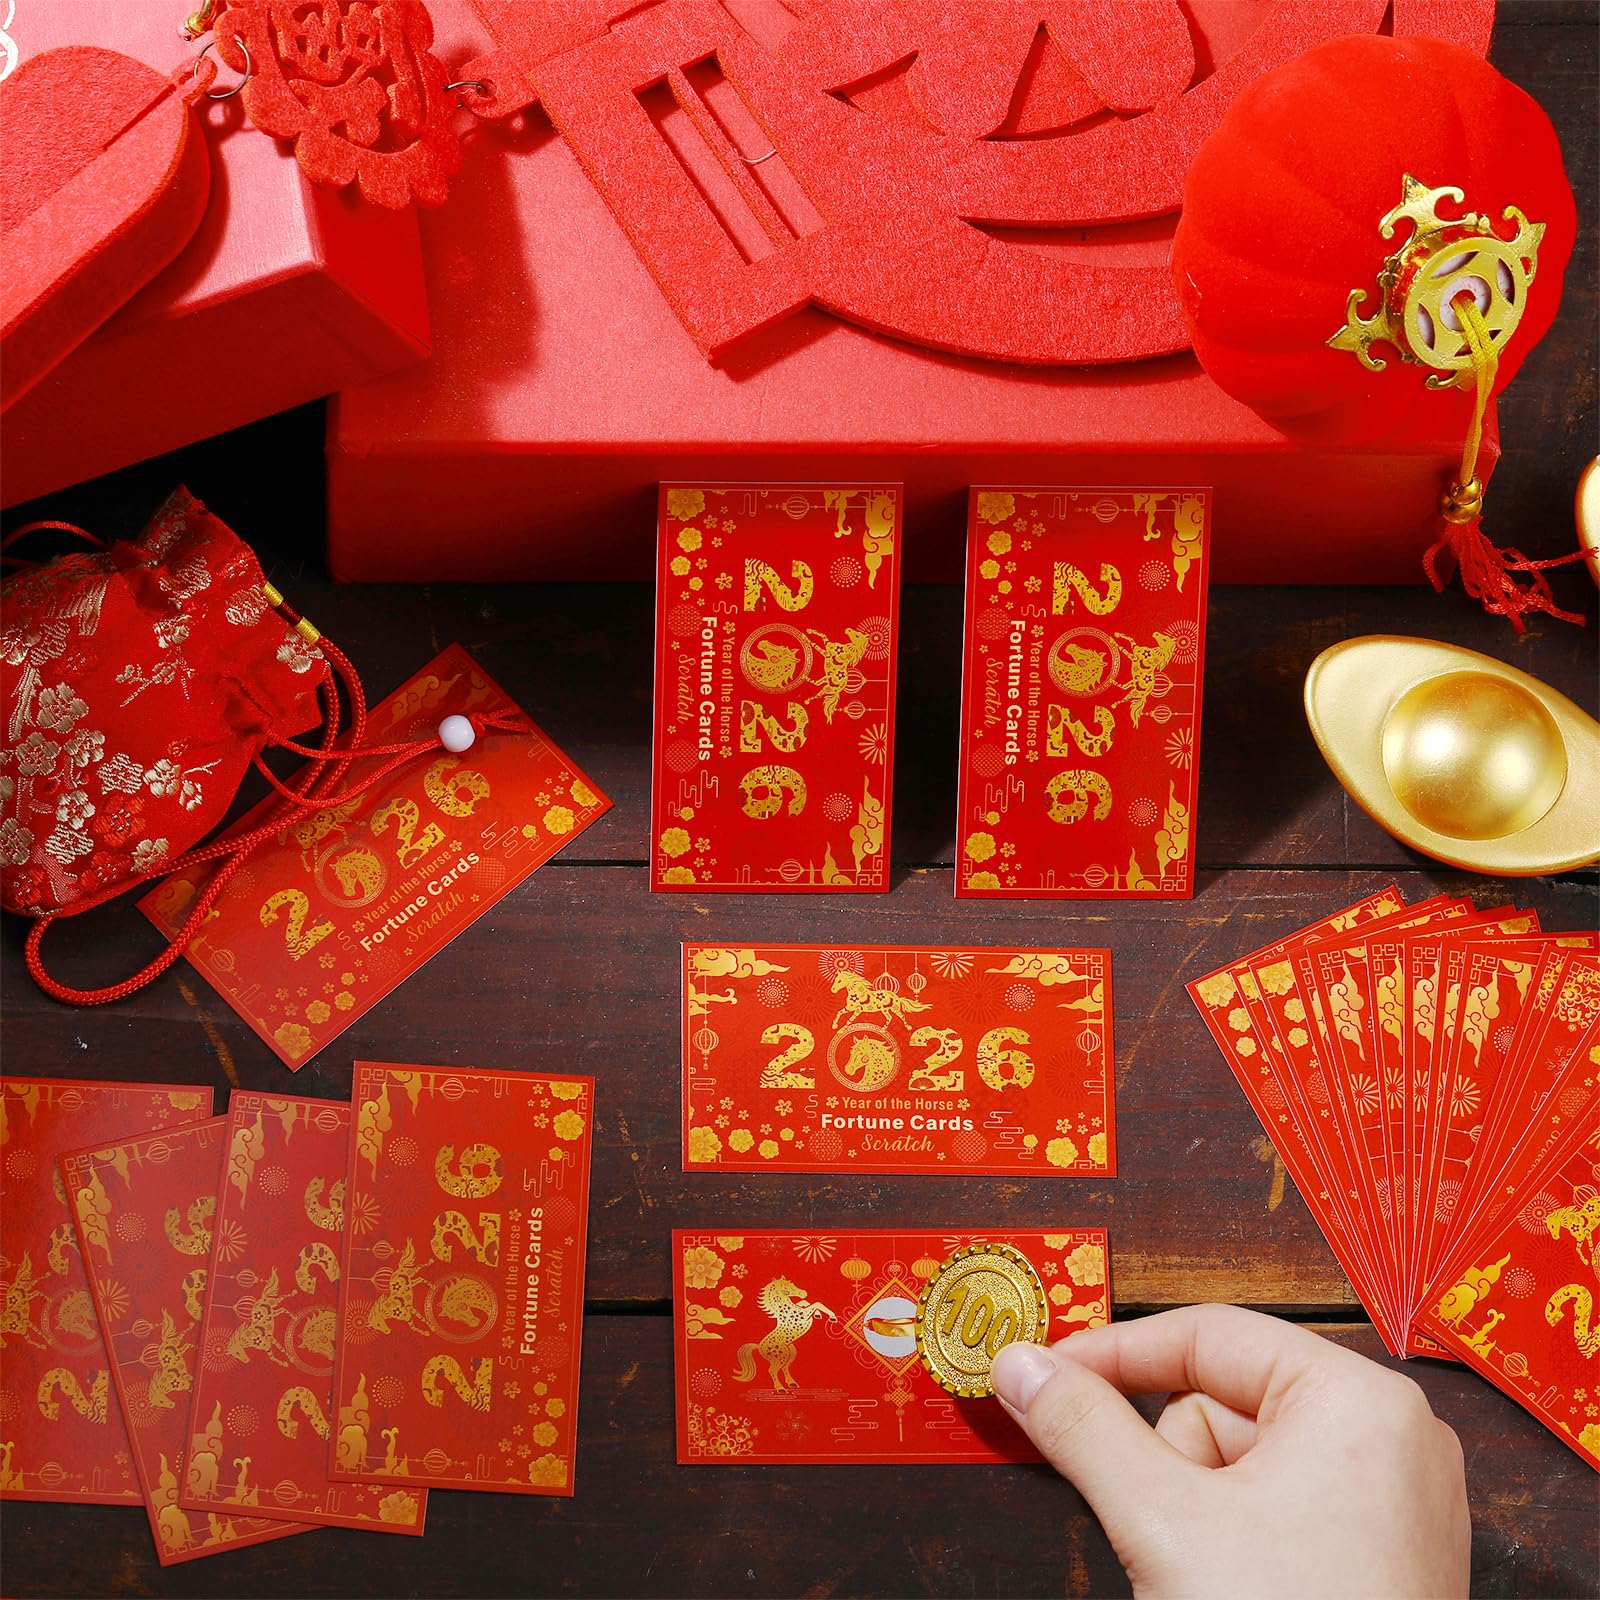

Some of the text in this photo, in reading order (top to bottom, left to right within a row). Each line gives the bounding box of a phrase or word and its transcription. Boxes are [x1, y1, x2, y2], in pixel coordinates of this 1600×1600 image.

[676, 653, 696, 724] Scratch
[698, 616, 718, 761] Fortune Cards
[719, 637, 735, 743] Year of the Horse
[983, 657, 1004, 728] Scratch
[1004, 620, 1026, 766] Fortune Cards
[1026, 640, 1043, 747] Year of the Horse
[359, 852, 480, 952] Fortune Cards
[363, 850, 452, 924] Year of the Horse
[405, 891, 465, 942] Scratch
[821, 1113, 974, 1131] Fortune Cards
[842, 1096, 954, 1110] Year of the Horse
[861, 1133, 935, 1152] Scratch
[502, 1224, 521, 1333] Year of the Horse
[519, 1207, 544, 1355] Fortune Cards
[543, 1246, 564, 1318] Scratch
[942, 1283, 1018, 1360] 100
